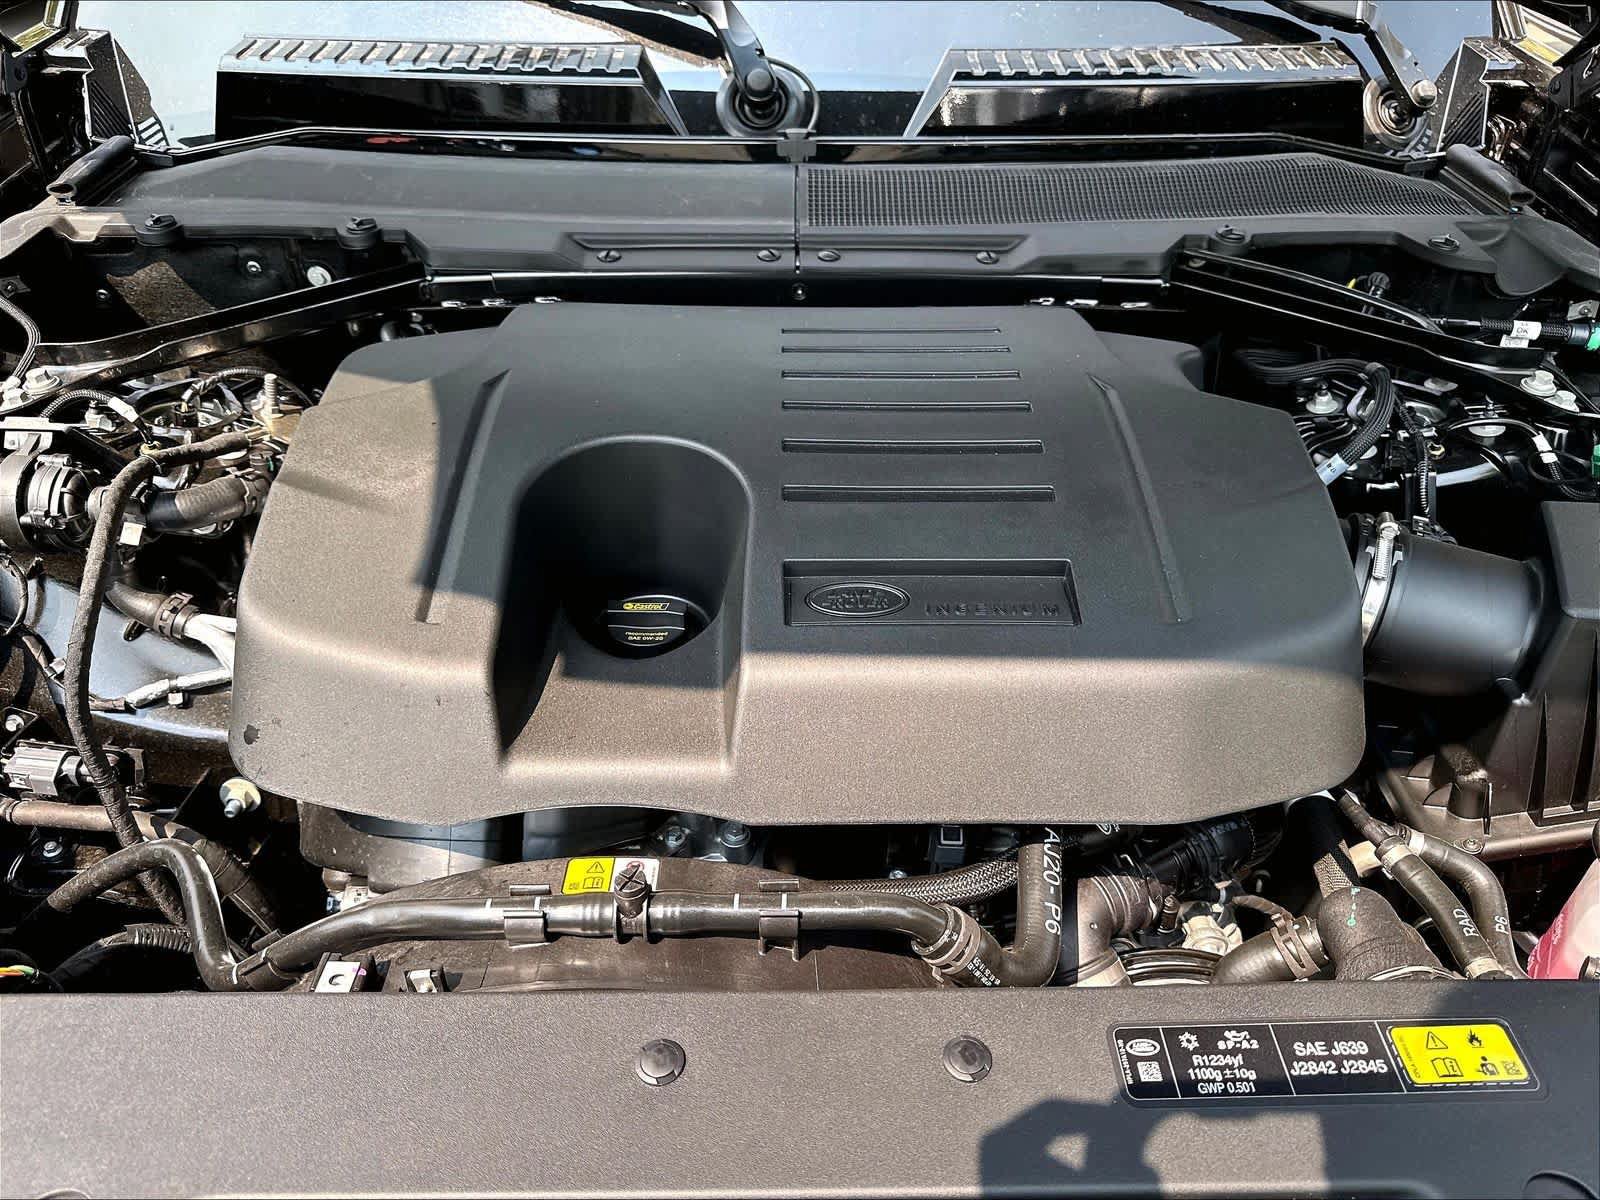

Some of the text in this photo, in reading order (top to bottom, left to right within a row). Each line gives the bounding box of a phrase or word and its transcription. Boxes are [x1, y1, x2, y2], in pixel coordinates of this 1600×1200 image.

[633, 603, 664, 611] Castrol
[923, 603, 1060, 617] INGENIUM
[1452, 908, 1480, 937] RAD
[1494, 915, 1510, 935] P6
[1293, 1040, 1369, 1057] SAE J639
[1290, 1059, 1389, 1076] J2842 J2845
[1197, 1082, 1257, 1095] GWP 0.501
